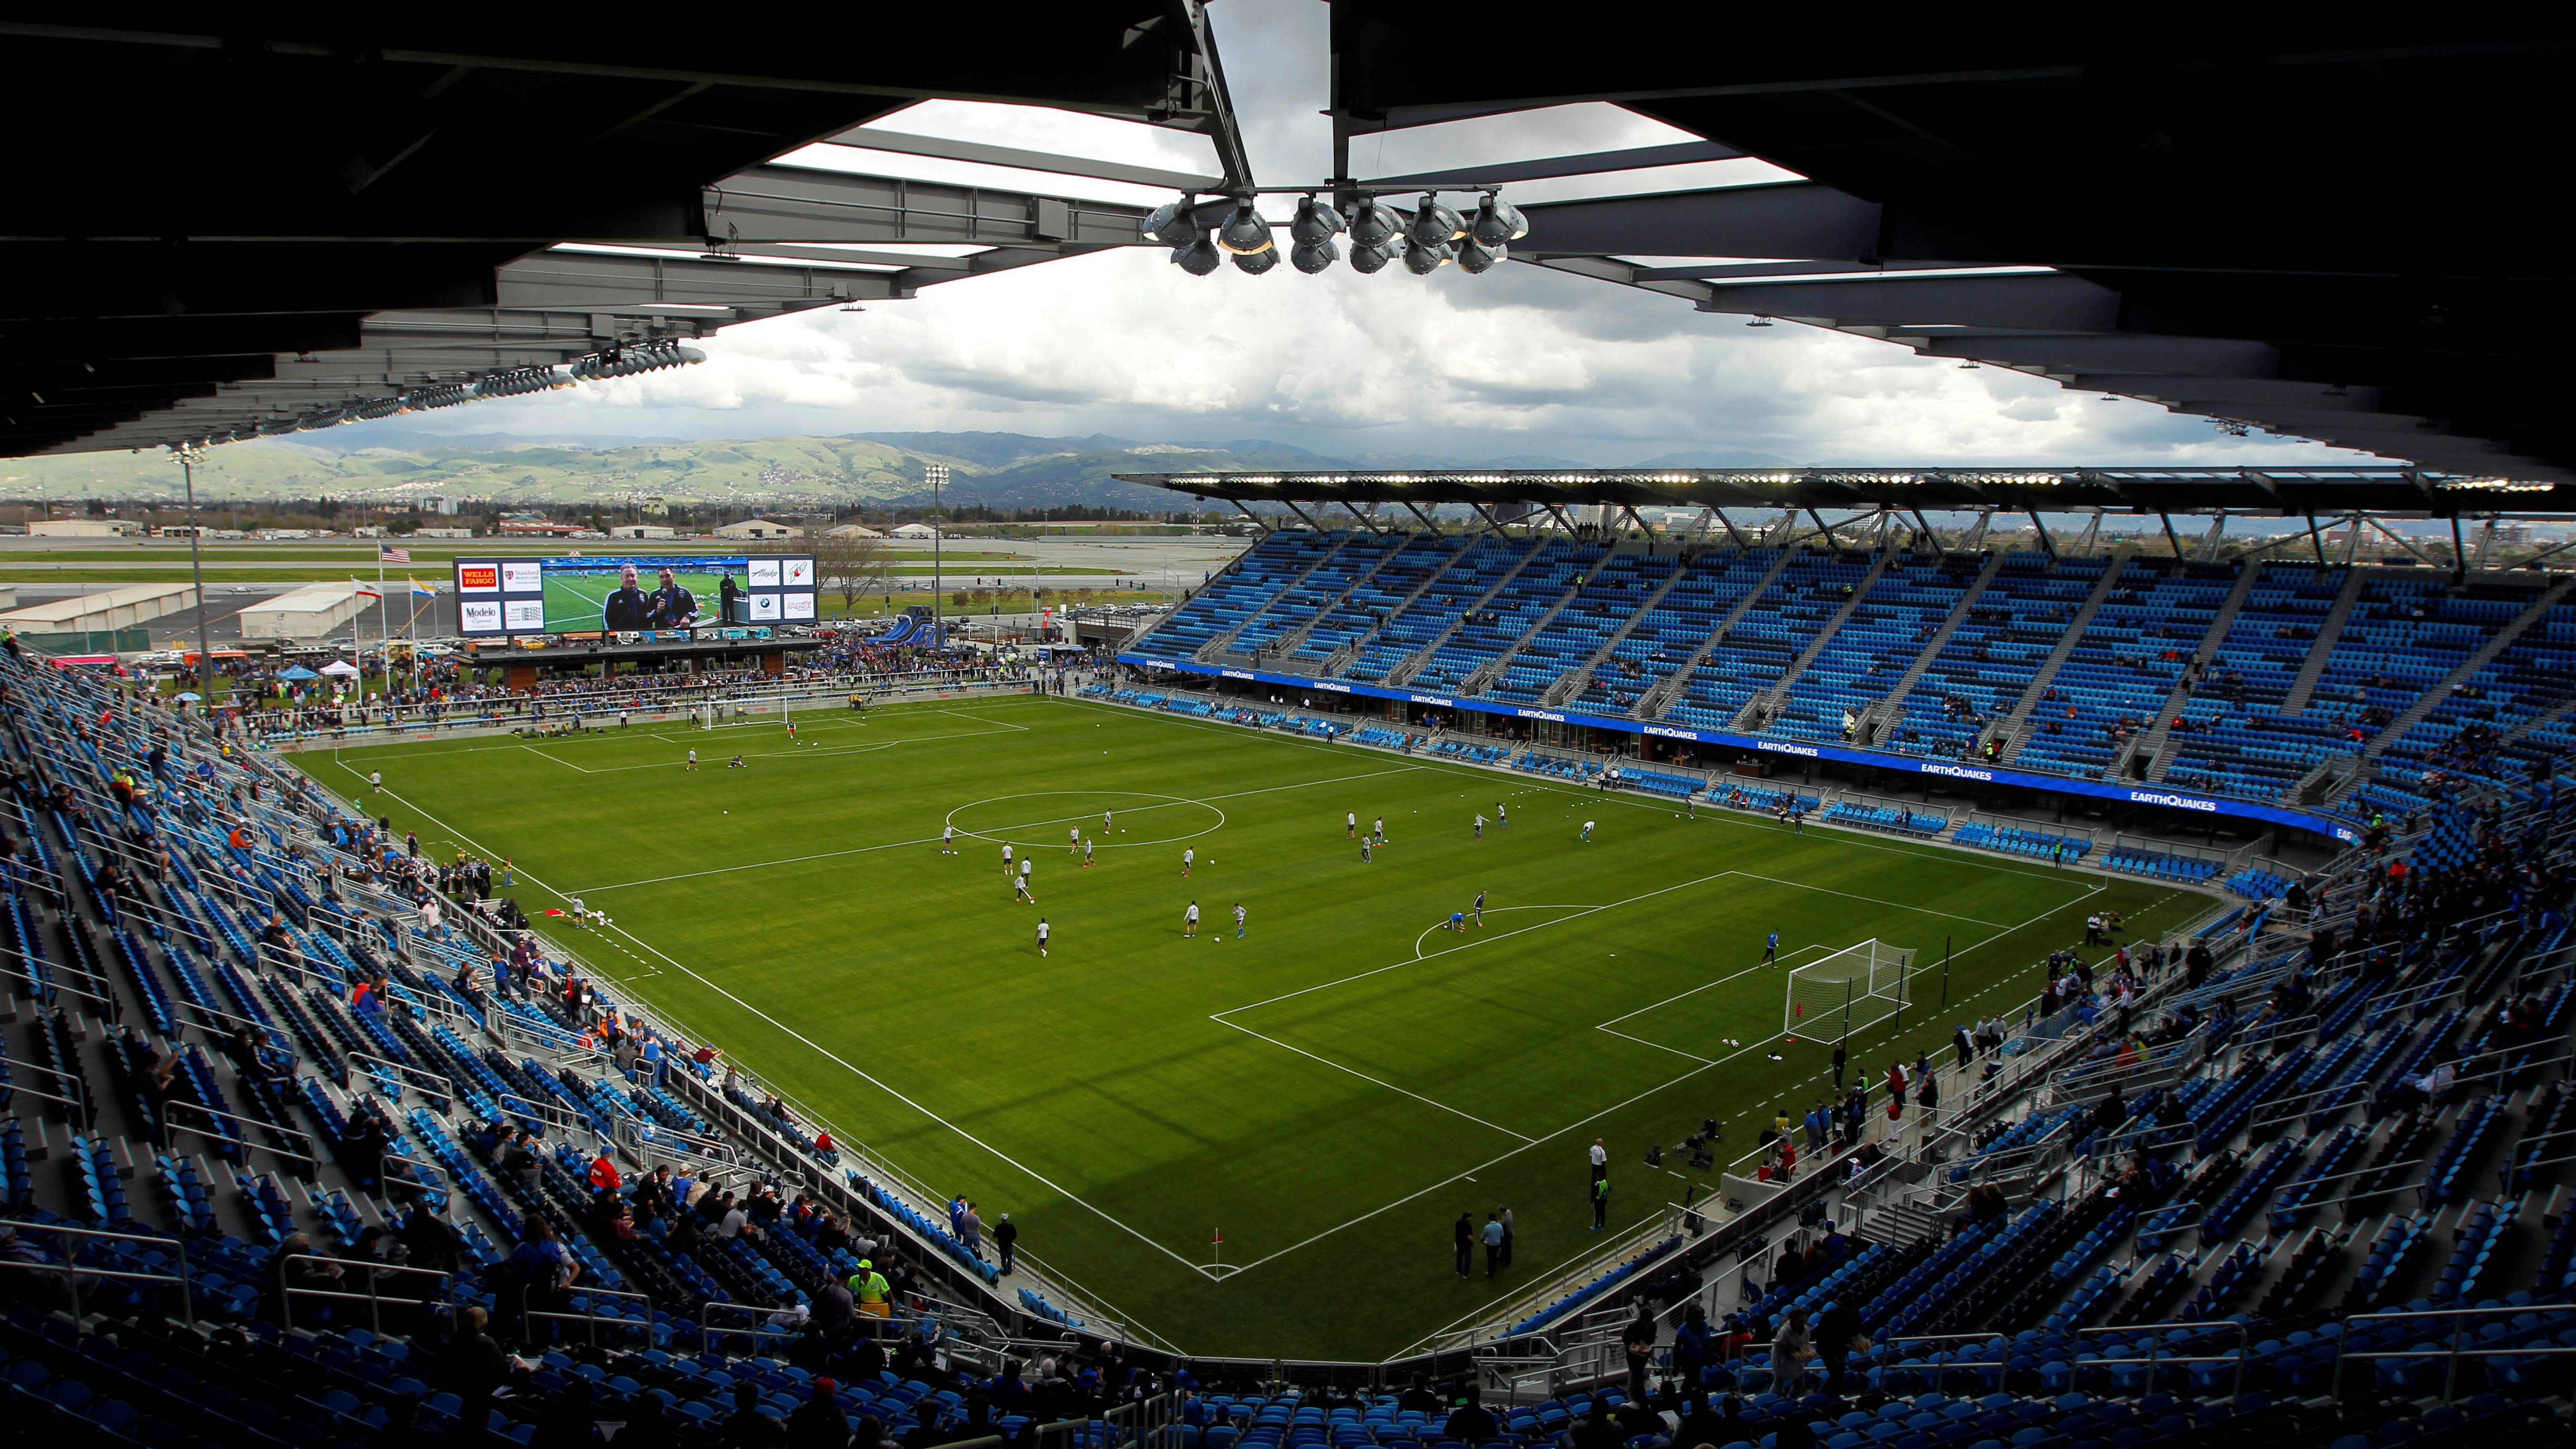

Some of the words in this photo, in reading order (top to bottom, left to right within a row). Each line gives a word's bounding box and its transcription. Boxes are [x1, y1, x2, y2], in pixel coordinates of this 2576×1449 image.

[751, 568, 778, 578] Alaska
[466, 607, 496, 618] Modelo
[1146, 660, 1175, 669] EARTHQUAKES
[1222, 670, 1254, 680] EARTHQUAKES
[1314, 682, 1350, 692] EARTHQUAKES
[1411, 695, 1452, 707] EARTHQUAKES
[1518, 709, 1565, 722] EARTHQUAKES
[1643, 726, 1697, 740] EARTHQUAKES
[1758, 741, 1818, 757] EARTHQUAKES
[1921, 763, 1992, 781] EARTHQUAKES
[2131, 791, 2216, 811] EARTHQUAKES
